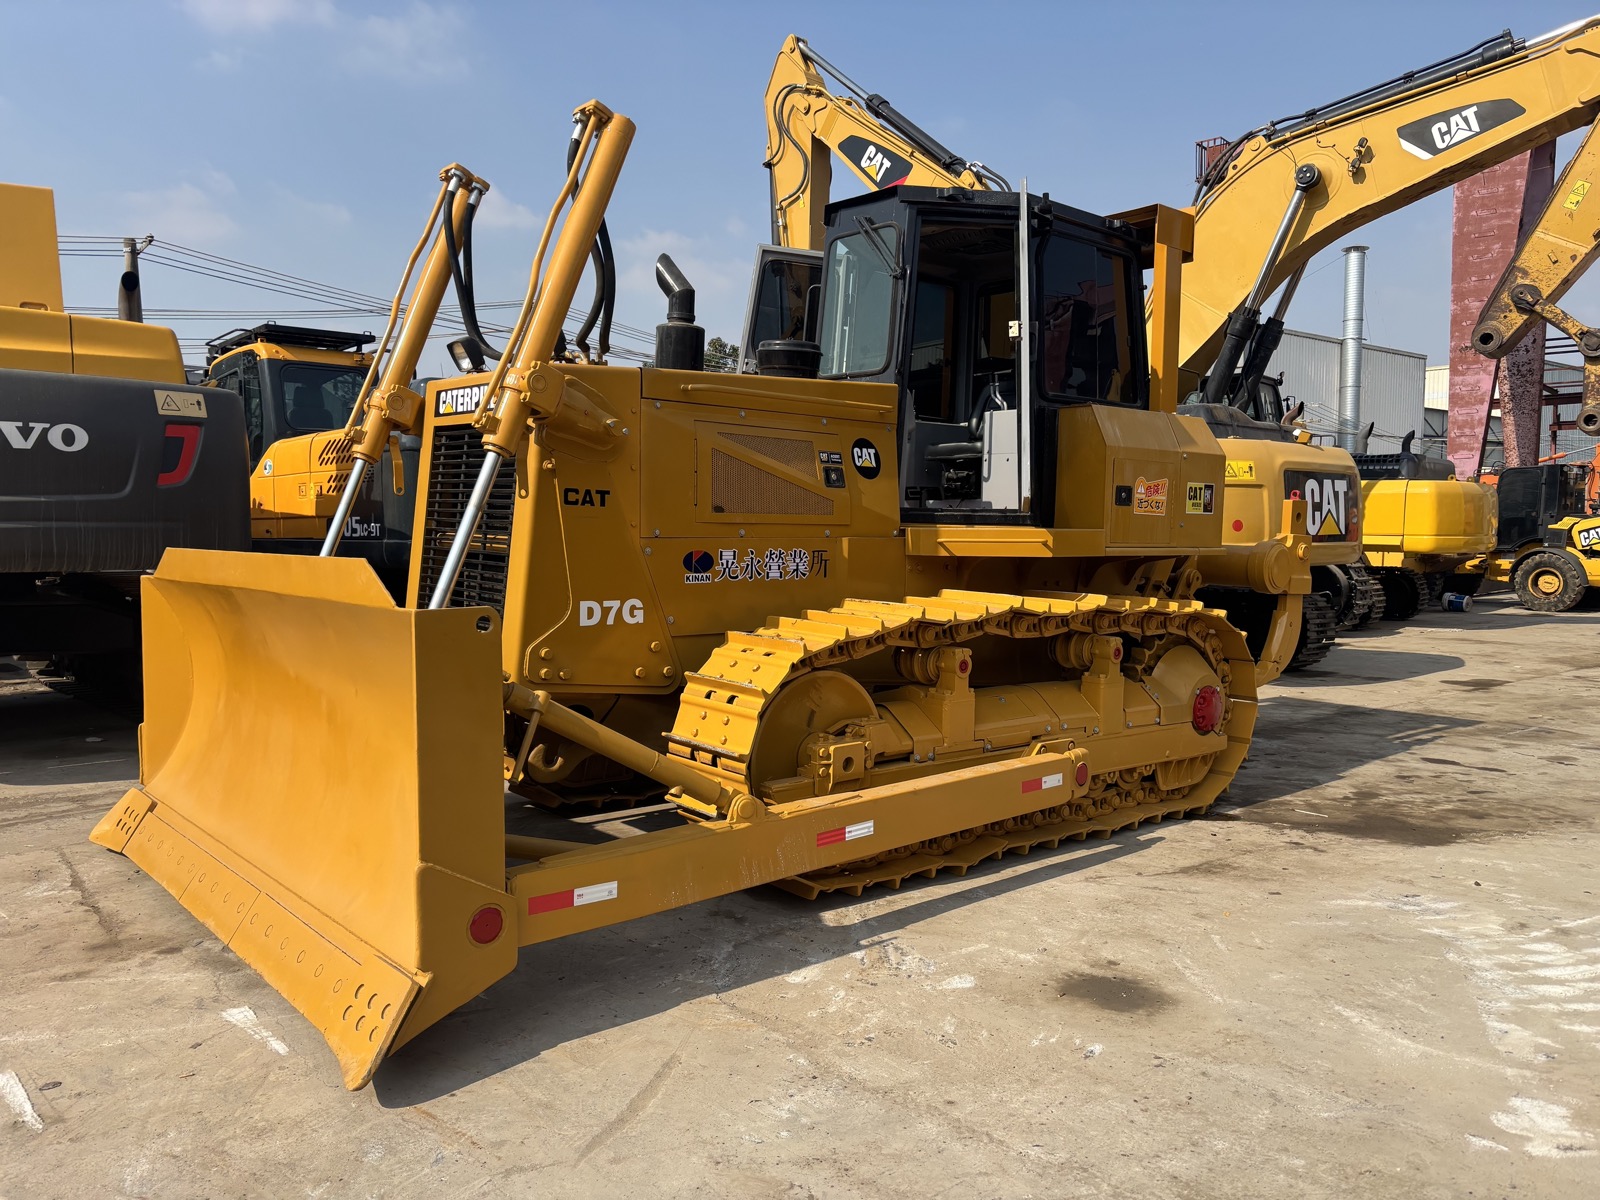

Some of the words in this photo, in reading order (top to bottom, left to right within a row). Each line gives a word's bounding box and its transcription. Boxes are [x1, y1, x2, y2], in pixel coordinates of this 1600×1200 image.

[1431, 105, 1481, 149] CAT
[860, 145, 891, 183] CAT
[853, 447, 876, 467] CAT
[563, 488, 611, 507] CAT
[1188, 486, 1203, 501] CAT
[1305, 478, 1348, 536] CAT
[685, 574, 712, 583] KINAN
[715, 548, 830, 582] 晃永營業所
[579, 598, 644, 626] D7G
